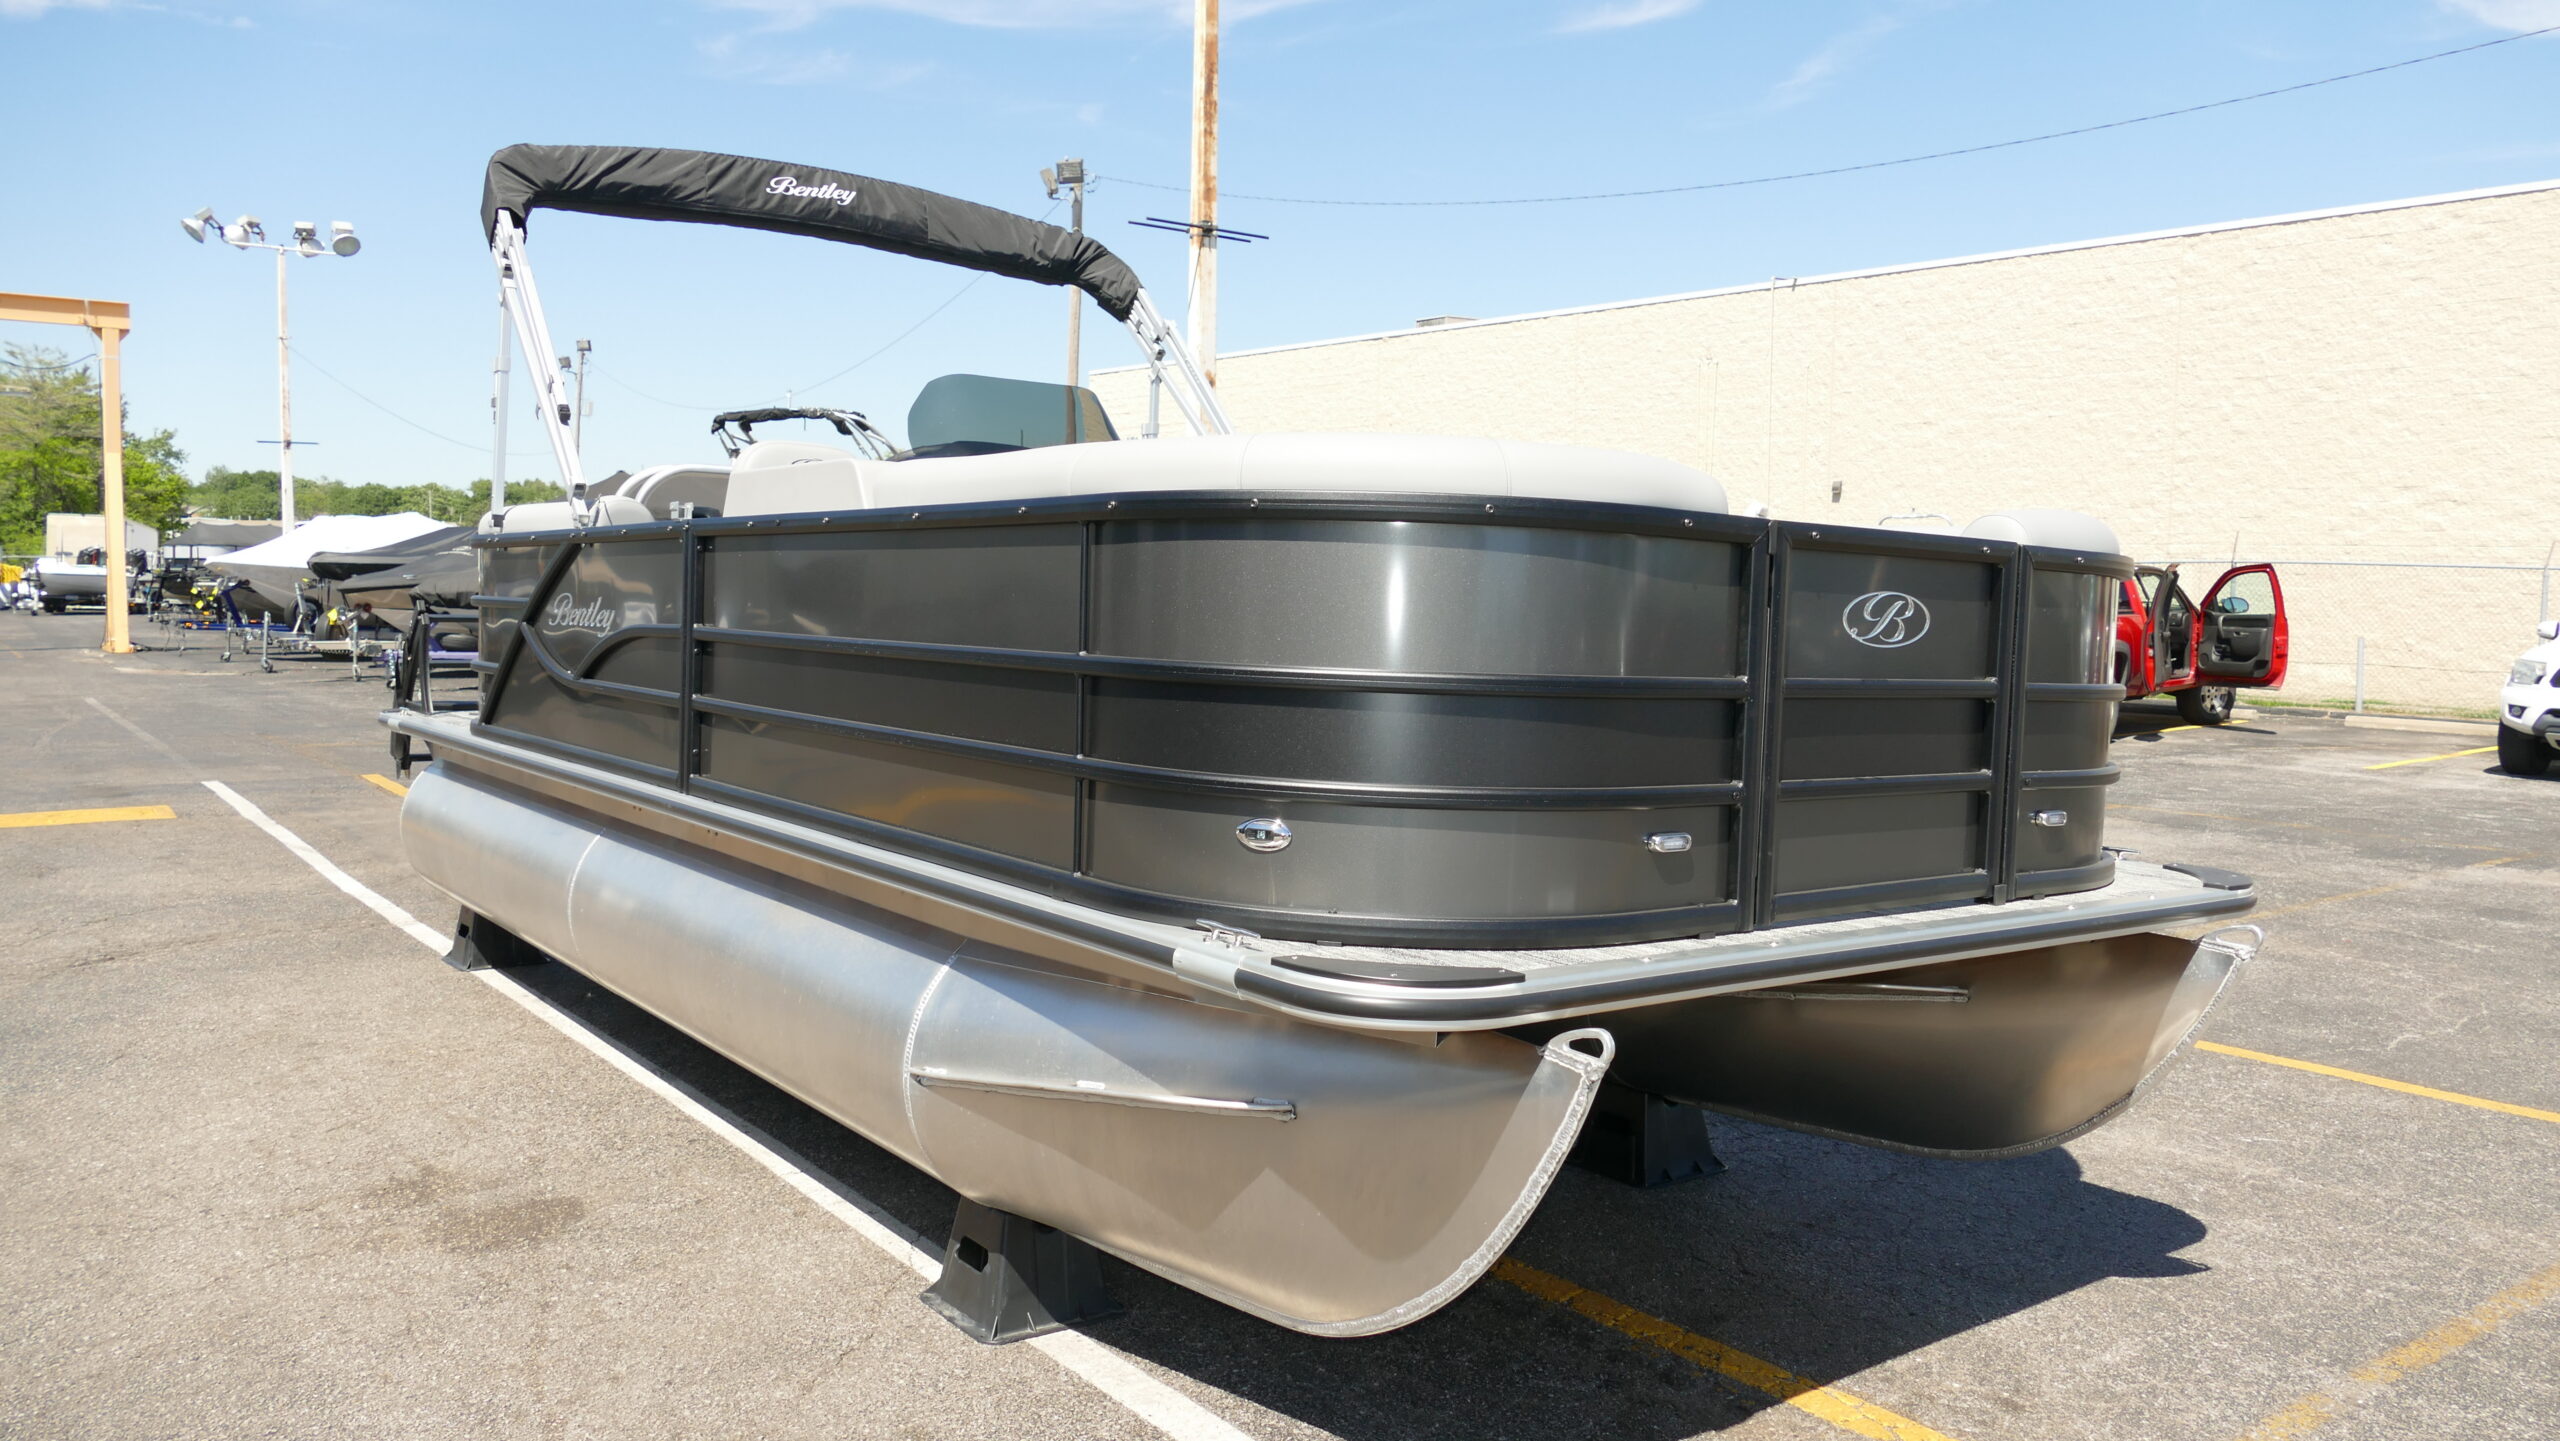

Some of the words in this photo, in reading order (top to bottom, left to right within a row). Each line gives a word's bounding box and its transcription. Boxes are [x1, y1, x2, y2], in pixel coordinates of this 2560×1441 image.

[765, 176, 857, 206] Bentley
[548, 592, 616, 638] Bentley
[1850, 592, 1915, 643] B
